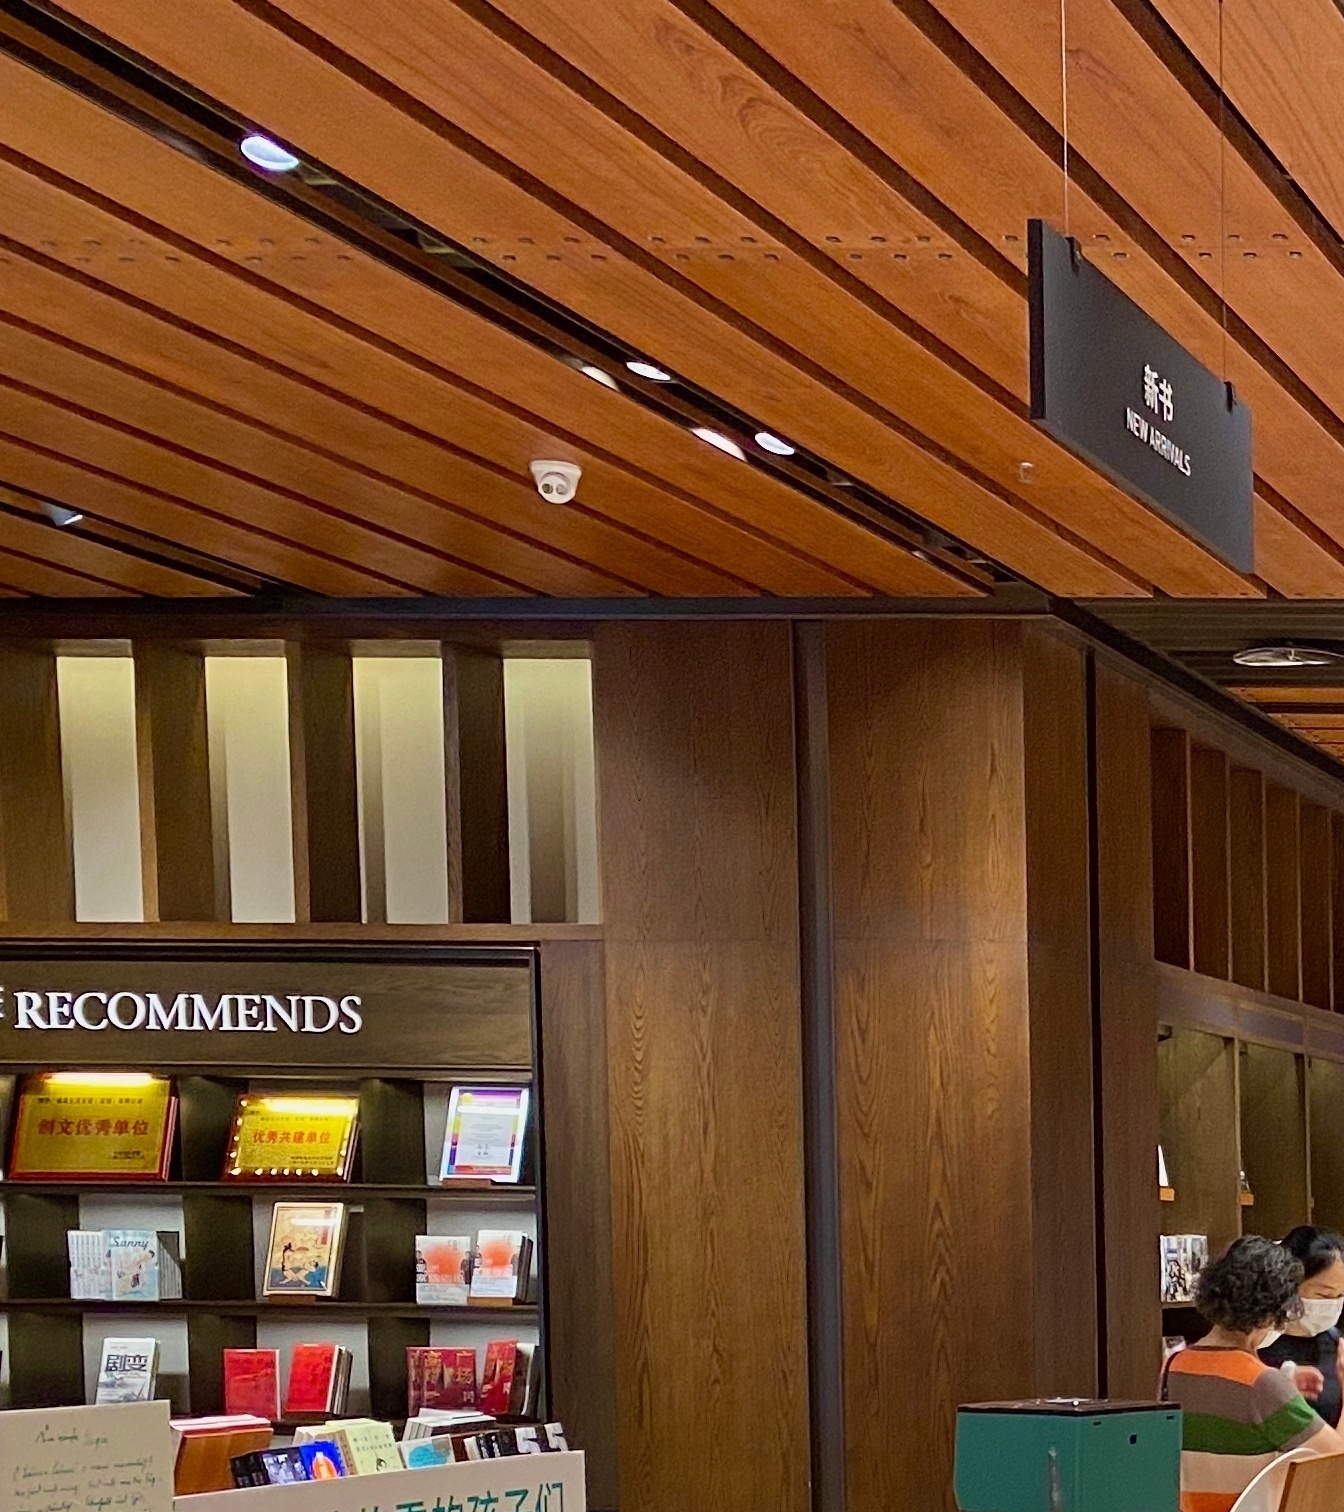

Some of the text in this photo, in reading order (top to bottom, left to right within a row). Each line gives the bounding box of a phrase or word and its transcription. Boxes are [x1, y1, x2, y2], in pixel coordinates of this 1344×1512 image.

[1142, 364, 1174, 422] 新书
[1126, 407, 1192, 477] NEW ARRIVALS
[14, 989, 363, 1035] RECOMMENDS
[252, 1129, 331, 1145] 优秀共建单位
[113, 1236, 150, 1251] Sunny
[104, 1354, 149, 1374] 剧变
